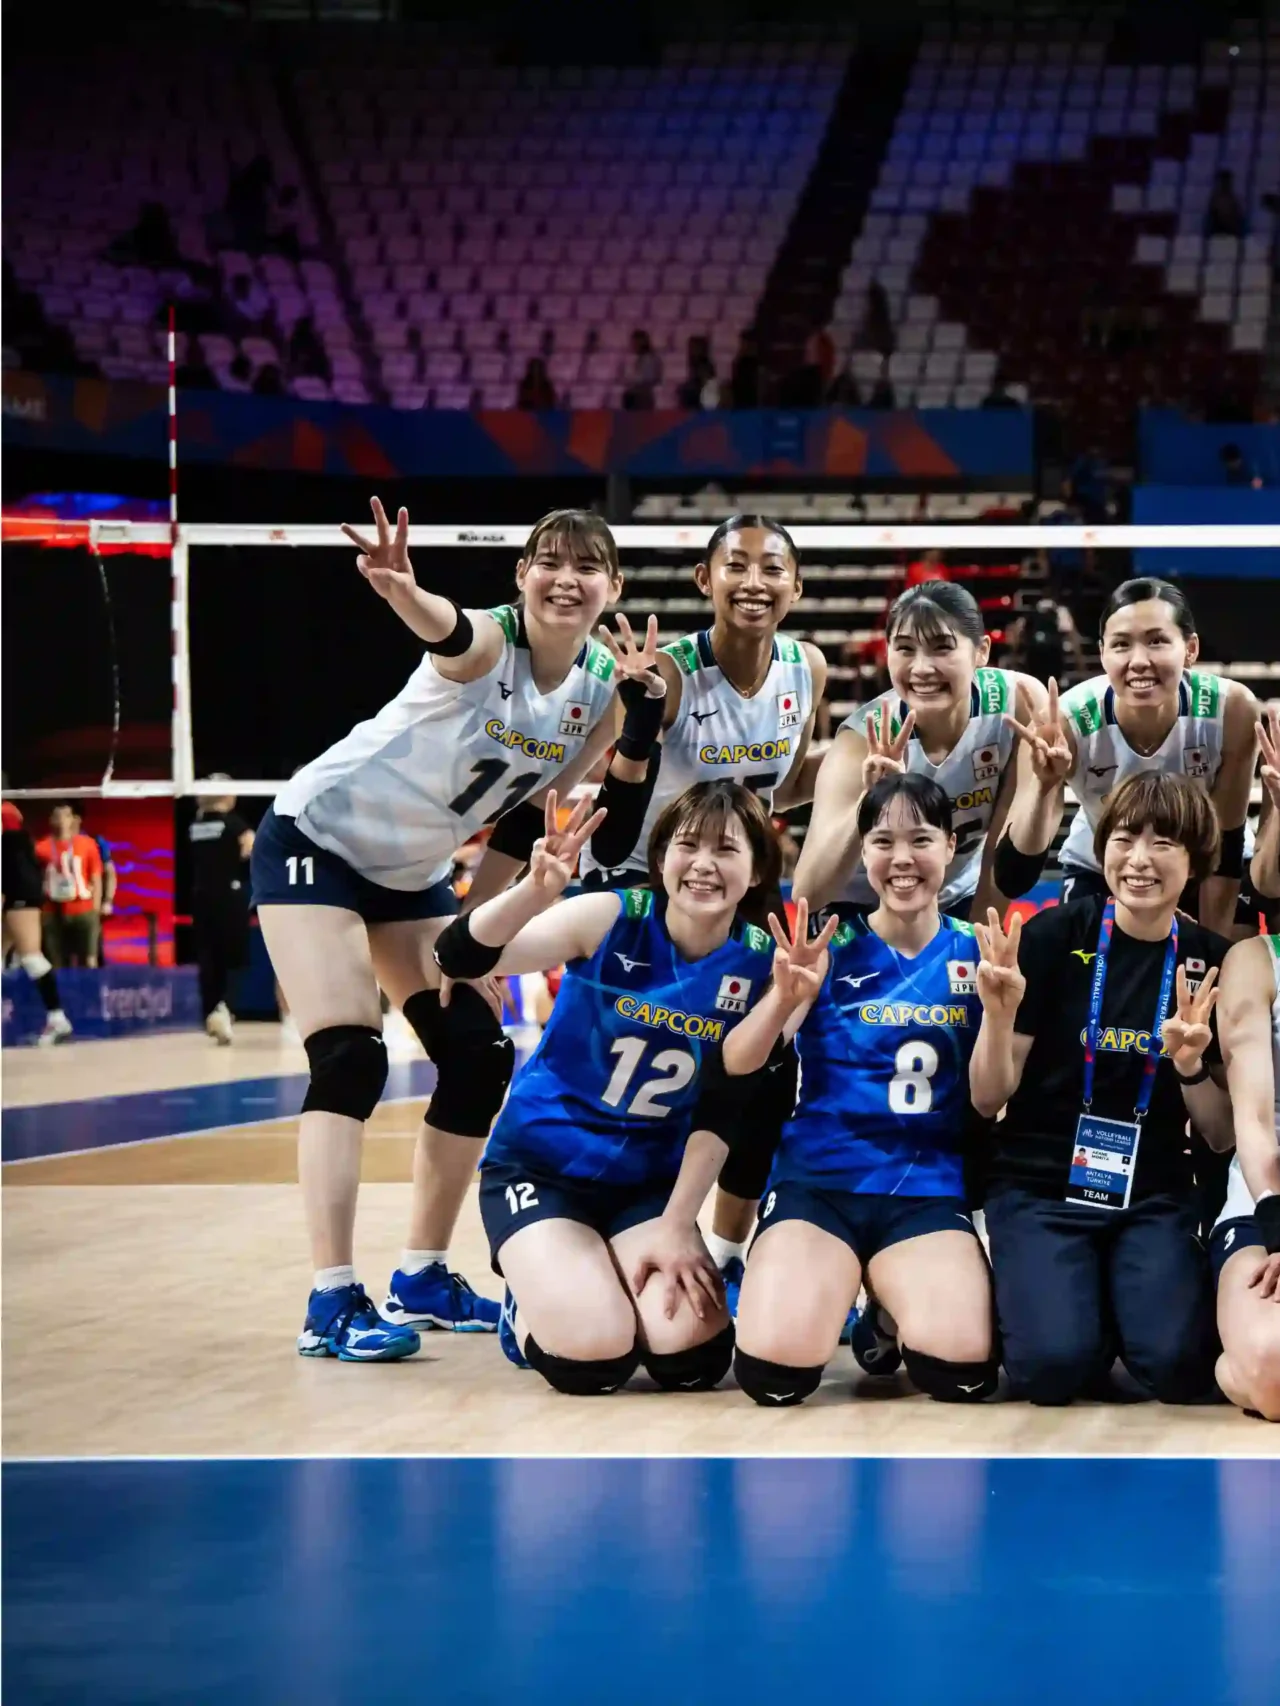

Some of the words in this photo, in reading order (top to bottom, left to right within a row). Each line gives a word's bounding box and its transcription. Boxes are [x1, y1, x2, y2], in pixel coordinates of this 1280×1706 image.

[563, 723, 583, 734] JPN
[781, 715, 797, 726] JPN
[485, 719, 566, 763] CAPCOM
[700, 737, 791, 764] CAPCOM
[448, 758, 543, 825] 11
[285, 856, 314, 885] 11
[954, 984, 974, 993] JPN
[615, 994, 725, 1042] CAPCOM
[720, 1000, 741, 1011] JPN
[859, 1004, 969, 1027] CAPCOM
[1080, 1027, 1172, 1058] APC
[601, 1036, 696, 1118] 12
[888, 1040, 938, 1114] 8
[1096, 1130, 1132, 1142] VOLLEYBALL
[505, 1182, 539, 1215] 12
[763, 1191, 777, 1219] 8
[1083, 1189, 1109, 1201] TEAM
